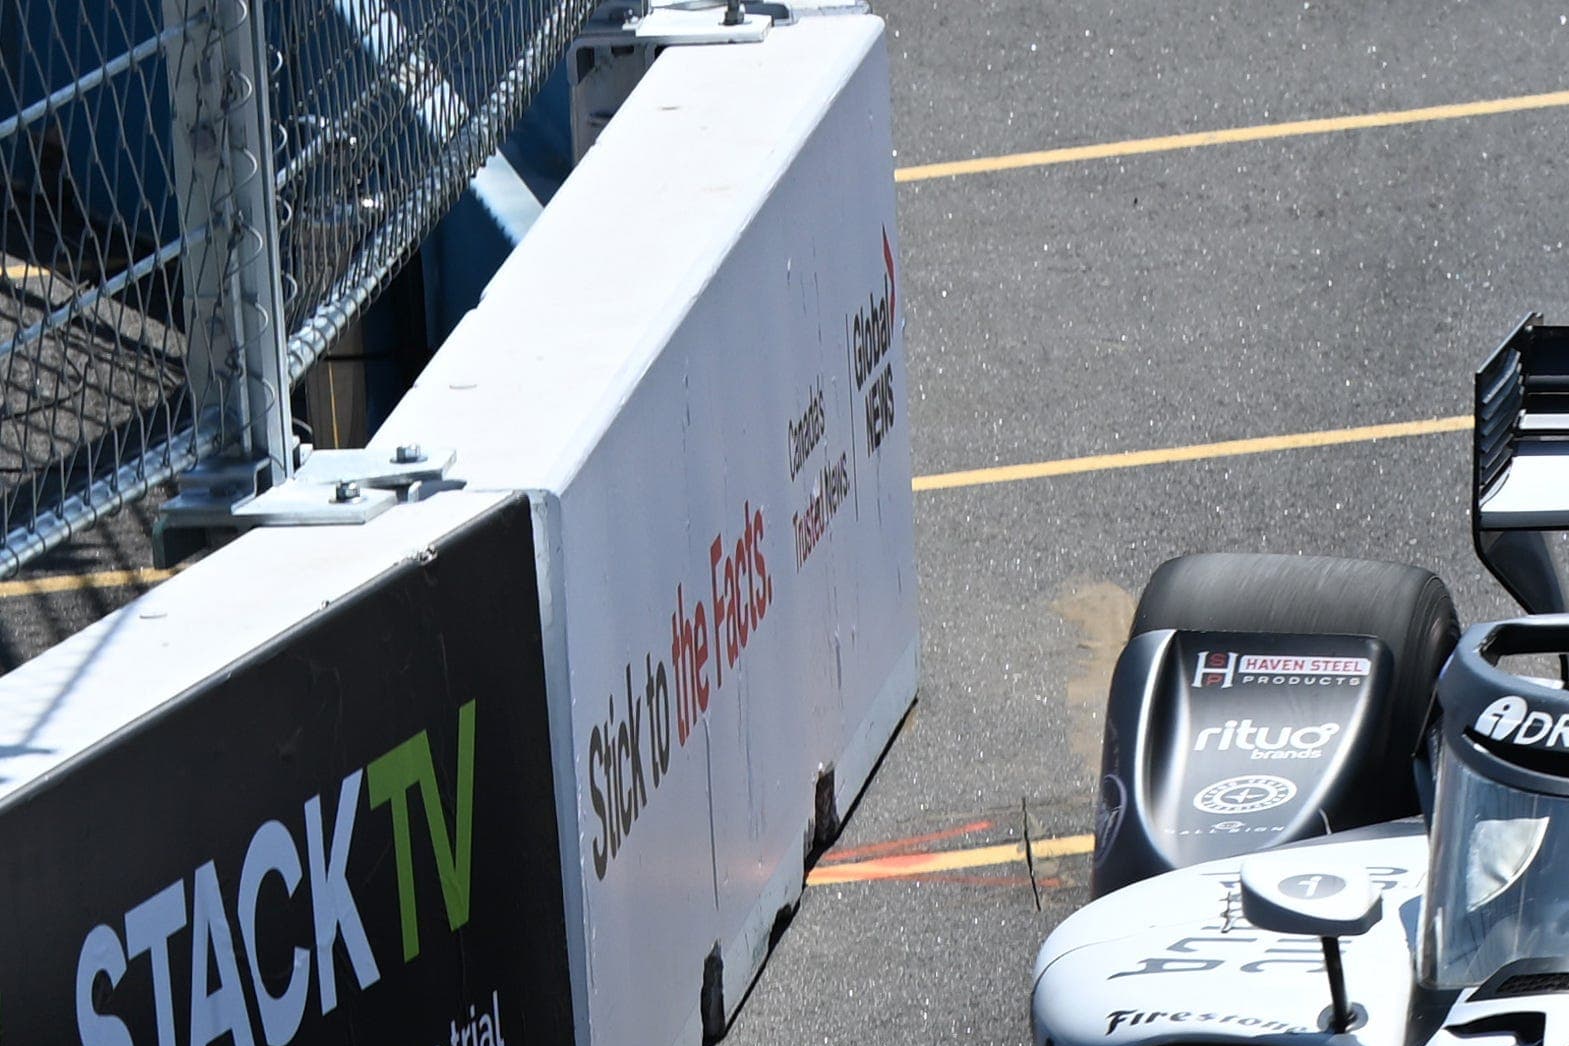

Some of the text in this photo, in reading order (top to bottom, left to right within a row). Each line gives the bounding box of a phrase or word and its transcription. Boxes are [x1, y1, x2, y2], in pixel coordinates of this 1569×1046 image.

[853, 272, 893, 392] Global
[788, 375, 826, 483] Canada's
[865, 363, 895, 459] NEWS
[792, 470, 828, 575] Trusted
[589, 500, 774, 882] Stick to the Facts.
[1242, 675, 1361, 686] PRODUCTS
[1245, 658, 1304, 671] HAVEN
[1310, 660, 1363, 673] STEEL
[1250, 749, 1322, 760] brands
